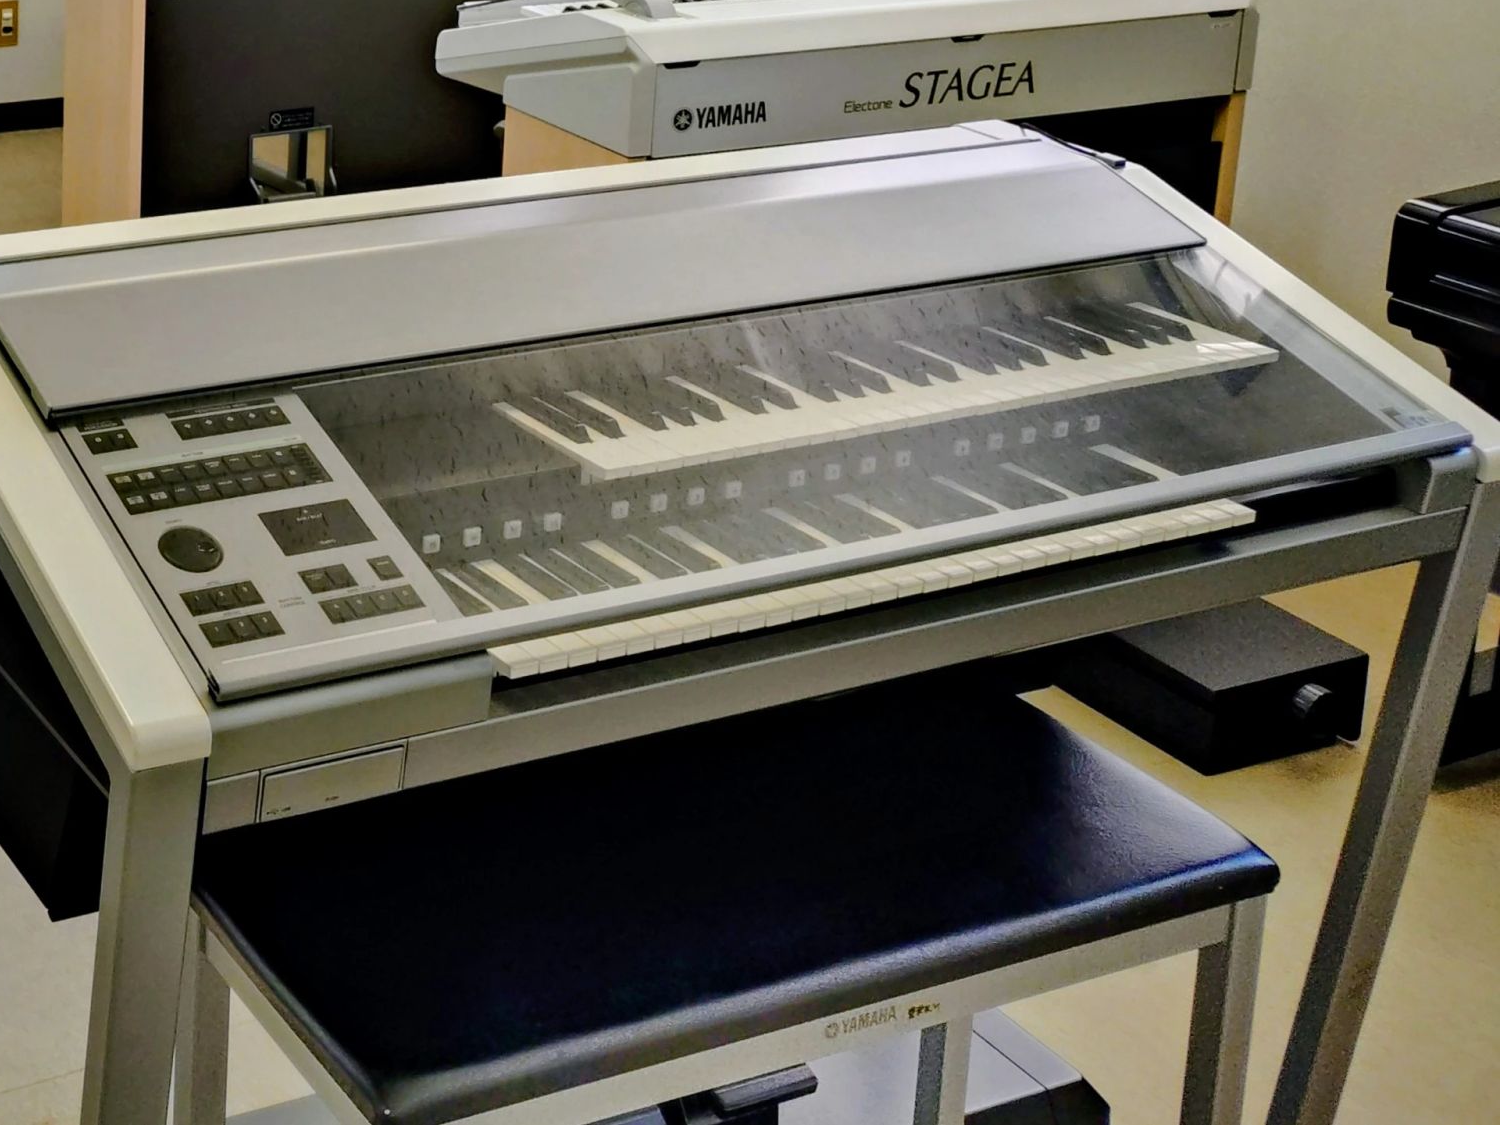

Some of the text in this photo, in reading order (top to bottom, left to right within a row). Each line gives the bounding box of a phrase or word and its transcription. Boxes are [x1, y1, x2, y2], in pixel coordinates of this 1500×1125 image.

[844, 60, 1035, 114] Electone STAGEA
[696, 101, 767, 129] YAMAHA
[842, 1006, 897, 1033] YAMAHA
